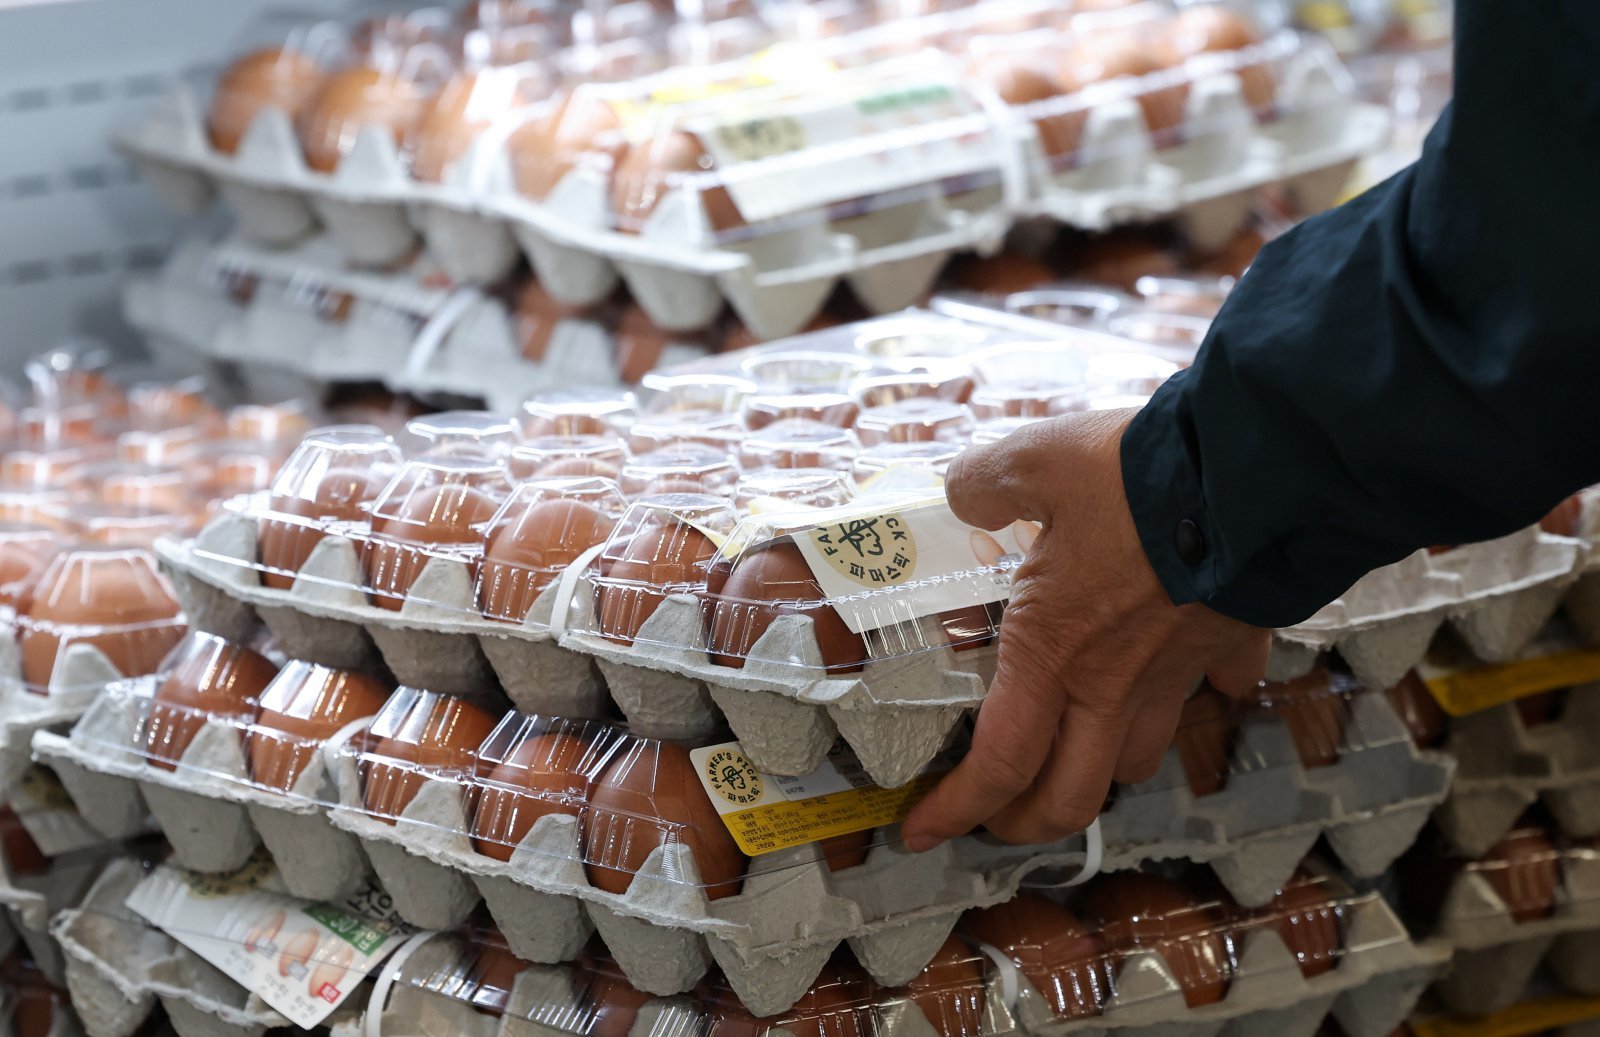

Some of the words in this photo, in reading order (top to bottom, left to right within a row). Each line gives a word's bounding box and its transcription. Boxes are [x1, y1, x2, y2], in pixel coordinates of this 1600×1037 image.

[849, 552, 911, 583] 파머스픽
[709, 752, 732, 789] FARMER'S
[736, 756, 759, 783] PICK
